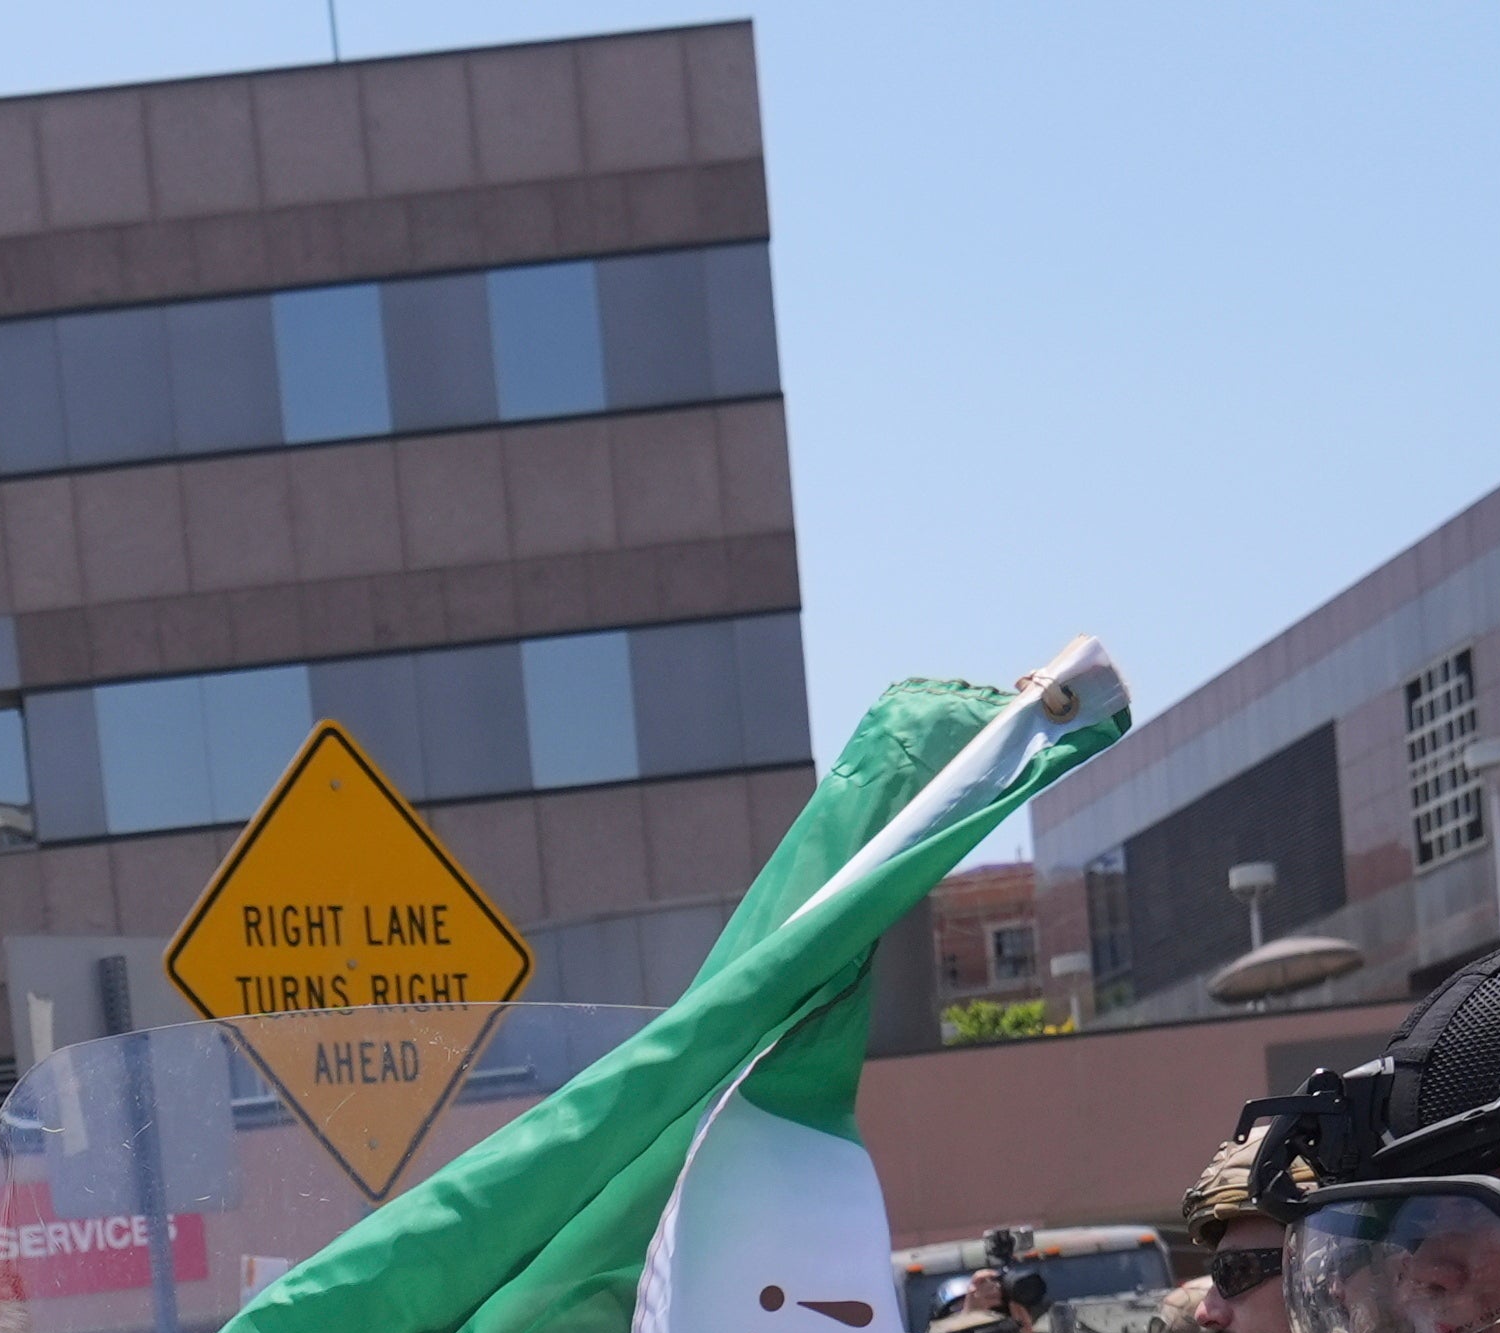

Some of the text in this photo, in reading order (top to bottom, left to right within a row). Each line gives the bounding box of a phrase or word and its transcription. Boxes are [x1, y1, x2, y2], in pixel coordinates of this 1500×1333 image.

[243, 904, 452, 948] RIGHT LANE
[236, 972, 469, 1020] TURNS RIGHT
[314, 1041, 421, 1086] AHEAD
